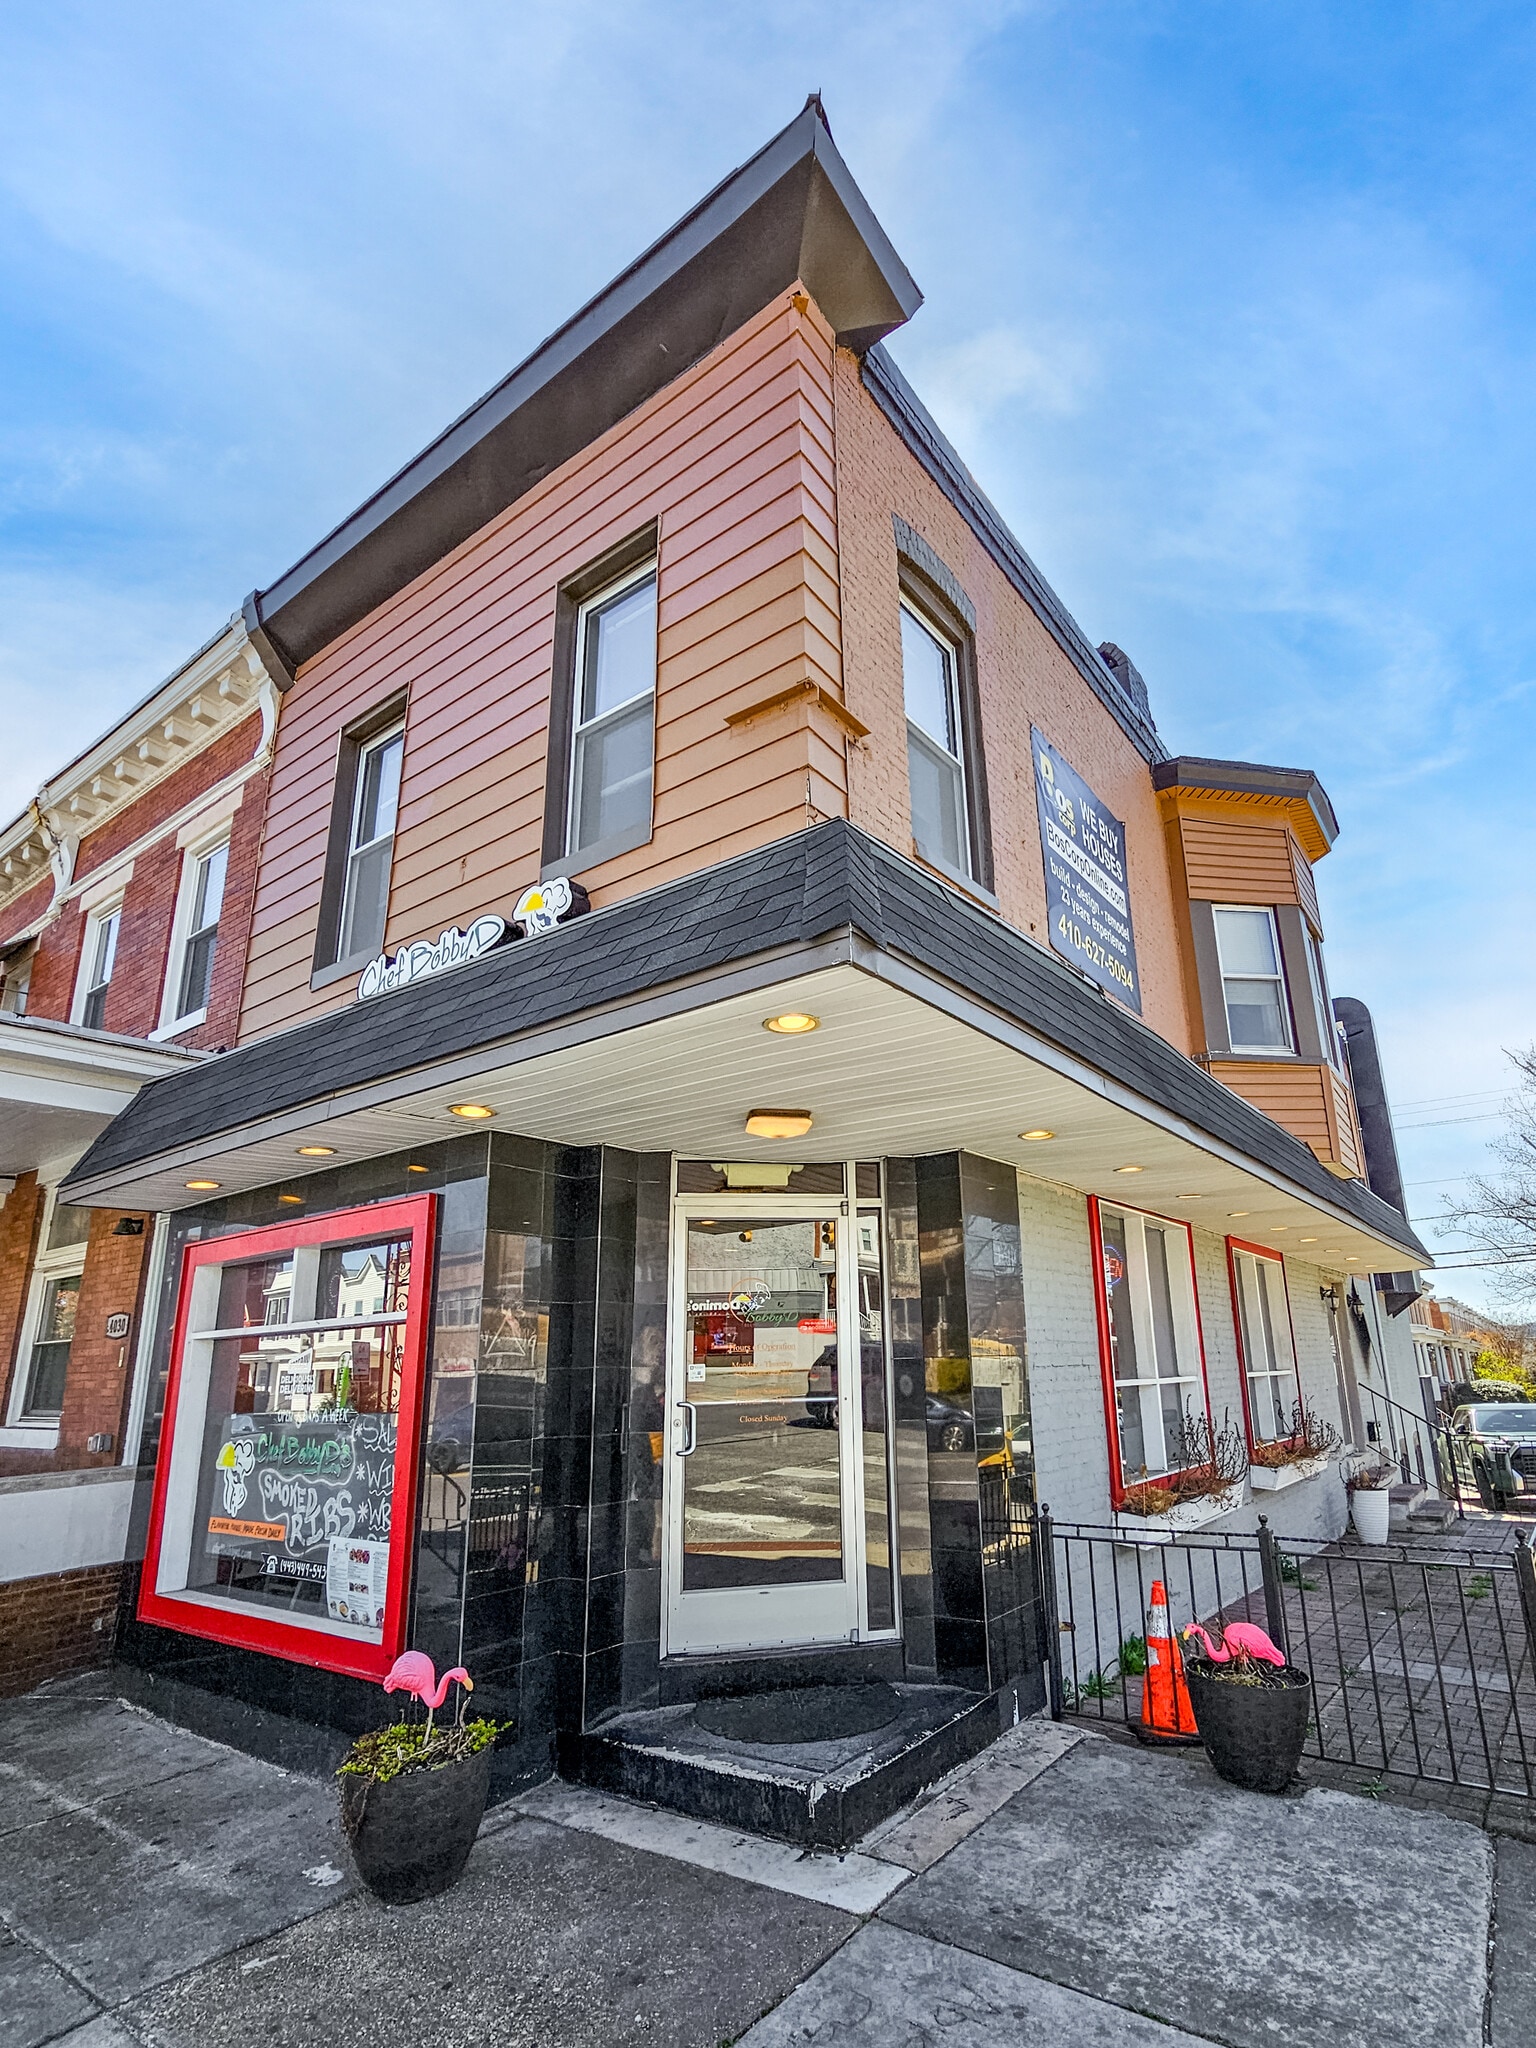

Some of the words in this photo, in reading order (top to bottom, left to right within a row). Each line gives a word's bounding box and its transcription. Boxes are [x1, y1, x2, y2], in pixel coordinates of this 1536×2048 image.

[1079, 797, 1098, 833] WE
[1098, 817, 1118, 854] BUY
[1082, 824, 1124, 881] HOUSES
[1047, 822, 1125, 910] BosCorpOnline.com
[1050, 857, 1071, 889] build
[1076, 882, 1100, 915] design
[1104, 911, 1130, 942] remodel
[1060, 886, 1070, 906] 23
[1071, 898, 1091, 925] years
[1091, 918, 1127, 956] experience
[361, 955, 405, 997] Chef
[1058, 914, 1134, 992] 410-627-5094
[109, 1318, 126, 1334] 4030
[361, 1415, 397, 1447] SAL
[740, 1415, 763, 1423] Closed
[764, 1414, 787, 1423] Sunday
[264, 1474, 319, 1522] SMOKED
[290, 1489, 356, 1547] RIBS
[280, 1559, 327, 1580] (443)449-543
